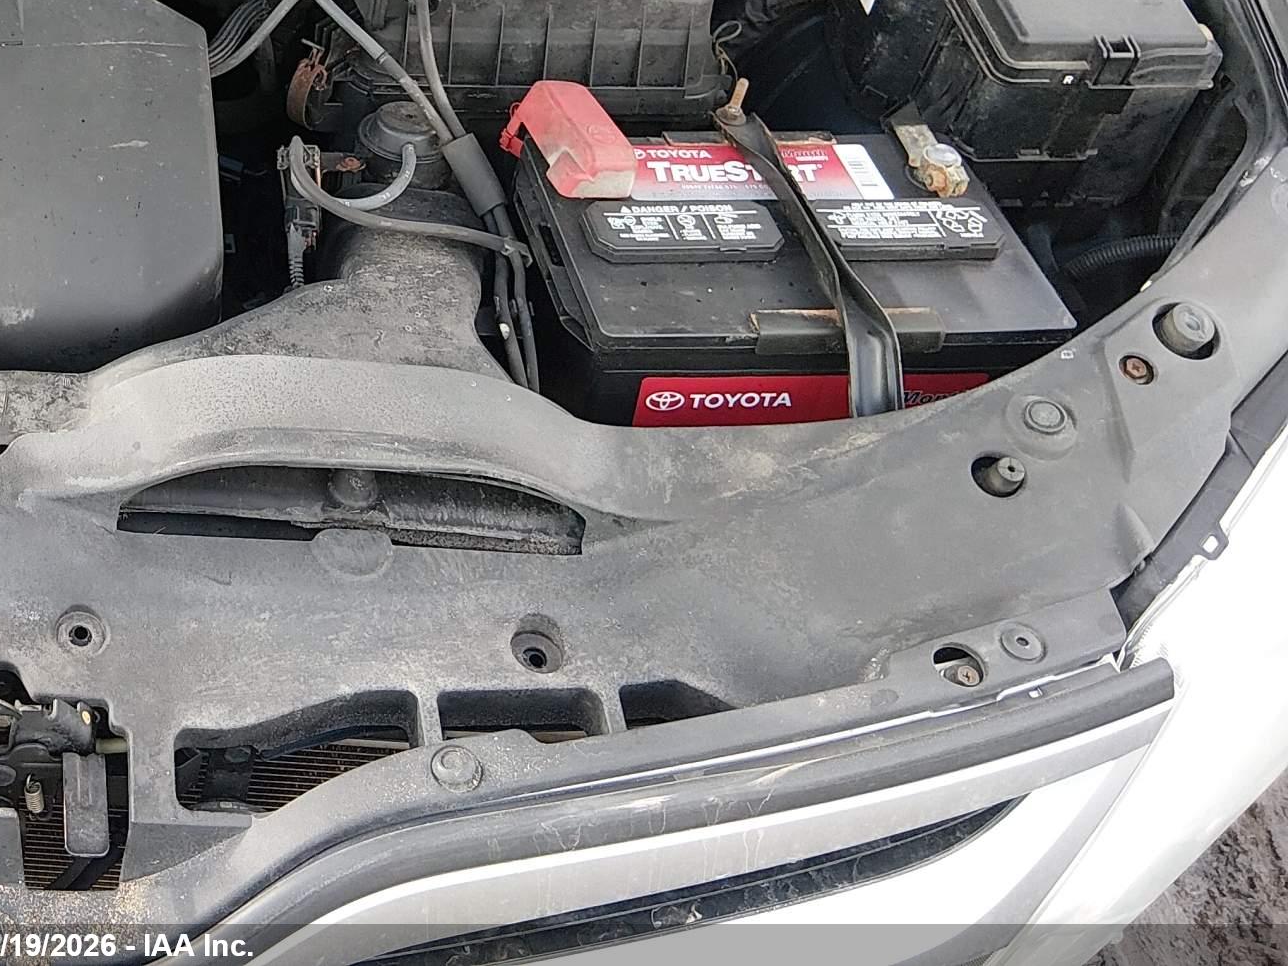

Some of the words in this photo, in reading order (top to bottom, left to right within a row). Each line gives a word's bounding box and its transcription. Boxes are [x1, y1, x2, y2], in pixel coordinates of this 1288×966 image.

[646, 149, 713, 159] TOYOTA
[631, 205, 680, 213] DANGER
[689, 204, 734, 212] POISON
[689, 392, 792, 409] TOYOTA
